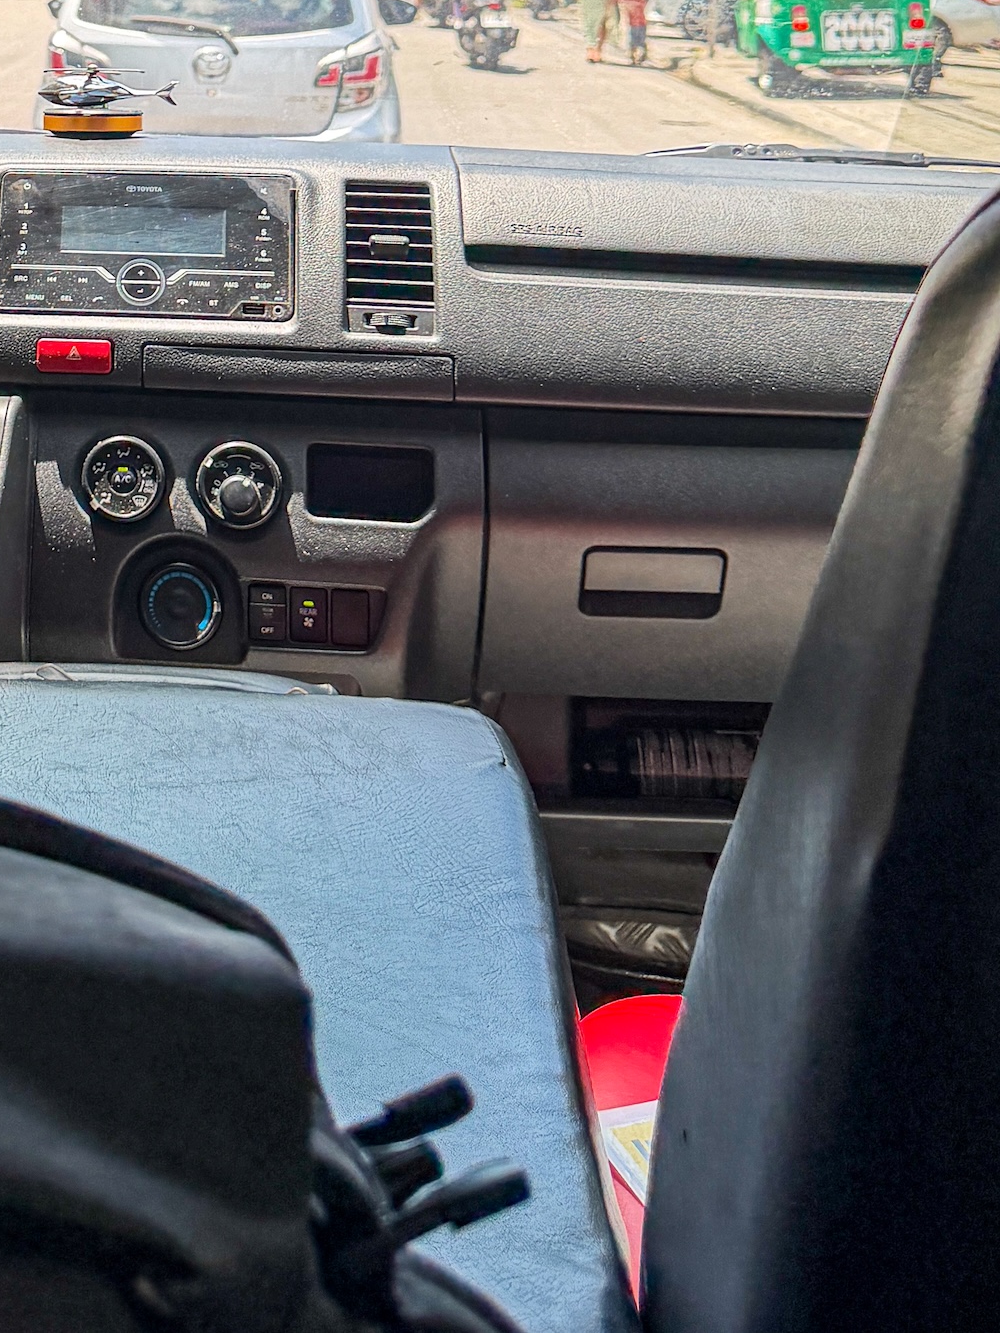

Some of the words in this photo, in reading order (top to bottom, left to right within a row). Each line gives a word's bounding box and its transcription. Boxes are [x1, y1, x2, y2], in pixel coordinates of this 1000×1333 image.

[223, 281, 240, 289] AMS
[114, 474, 131, 484] A/C
[299, 607, 318, 616] REAR
[260, 626, 275, 634] OFF
